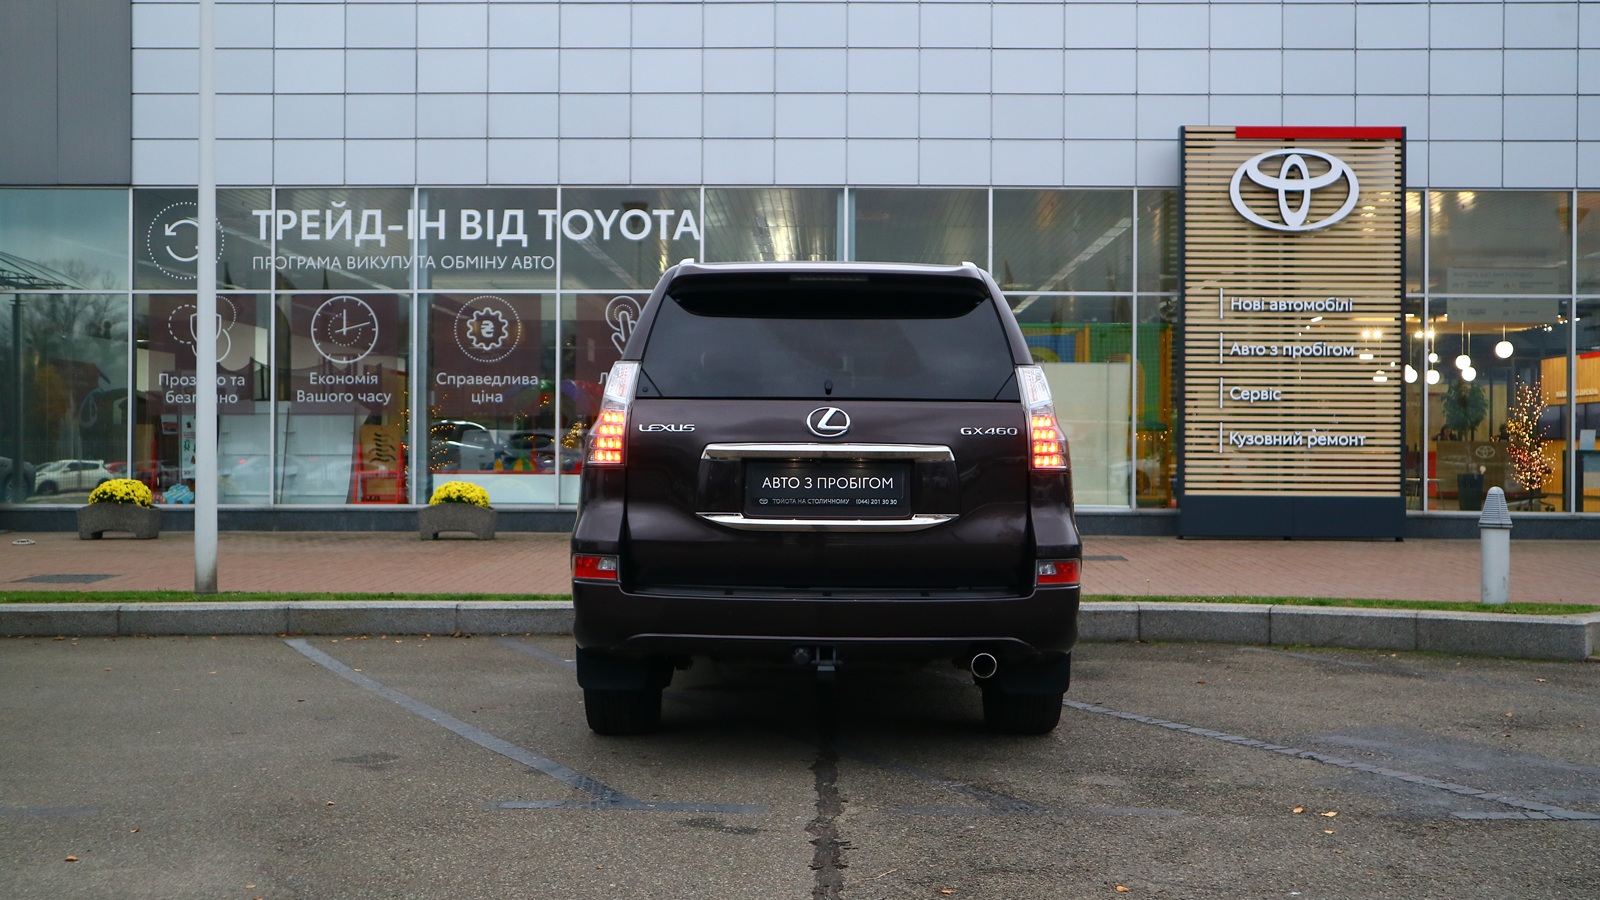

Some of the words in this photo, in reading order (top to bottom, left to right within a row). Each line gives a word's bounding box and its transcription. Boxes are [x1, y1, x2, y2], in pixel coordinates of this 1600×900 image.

[252, 201, 446, 247] ТРЕЙД-ІН
[460, 209, 528, 247] ВІД
[538, 209, 701, 240] TOYOTA
[252, 256, 342, 270] ПРОГРАМА
[347, 256, 412, 270] ВИКУПУ
[416, 256, 436, 269] ТА
[441, 255, 507, 269] ОБМІНУ
[511, 255, 555, 269] АВТО
[1230, 297, 1265, 312] Нові
[1269, 297, 1353, 312] автомобілі
[1229, 342, 1266, 356] Авто
[1269, 345, 1279, 356] з
[1282, 342, 1355, 359] пробігом
[158, 373, 226, 389] Прозо
[230, 376, 246, 386] та
[309, 371, 378, 385] Економія
[436, 372, 538, 389] Справедлива
[296, 389, 354, 403] Вашого
[357, 392, 391, 405] часу
[471, 389, 503, 405] ціна
[1229, 386, 1282, 404] Сервіс
[638, 423, 696, 433] LEXUS
[960, 426, 1018, 436] GX460
[1229, 431, 1303, 448] Кузовний
[1307, 434, 1366, 449] ремонт
[761, 477, 800, 489] АВТО
[804, 477, 813, 489] З
[817, 477, 894, 489] ПРОБІГОМ
